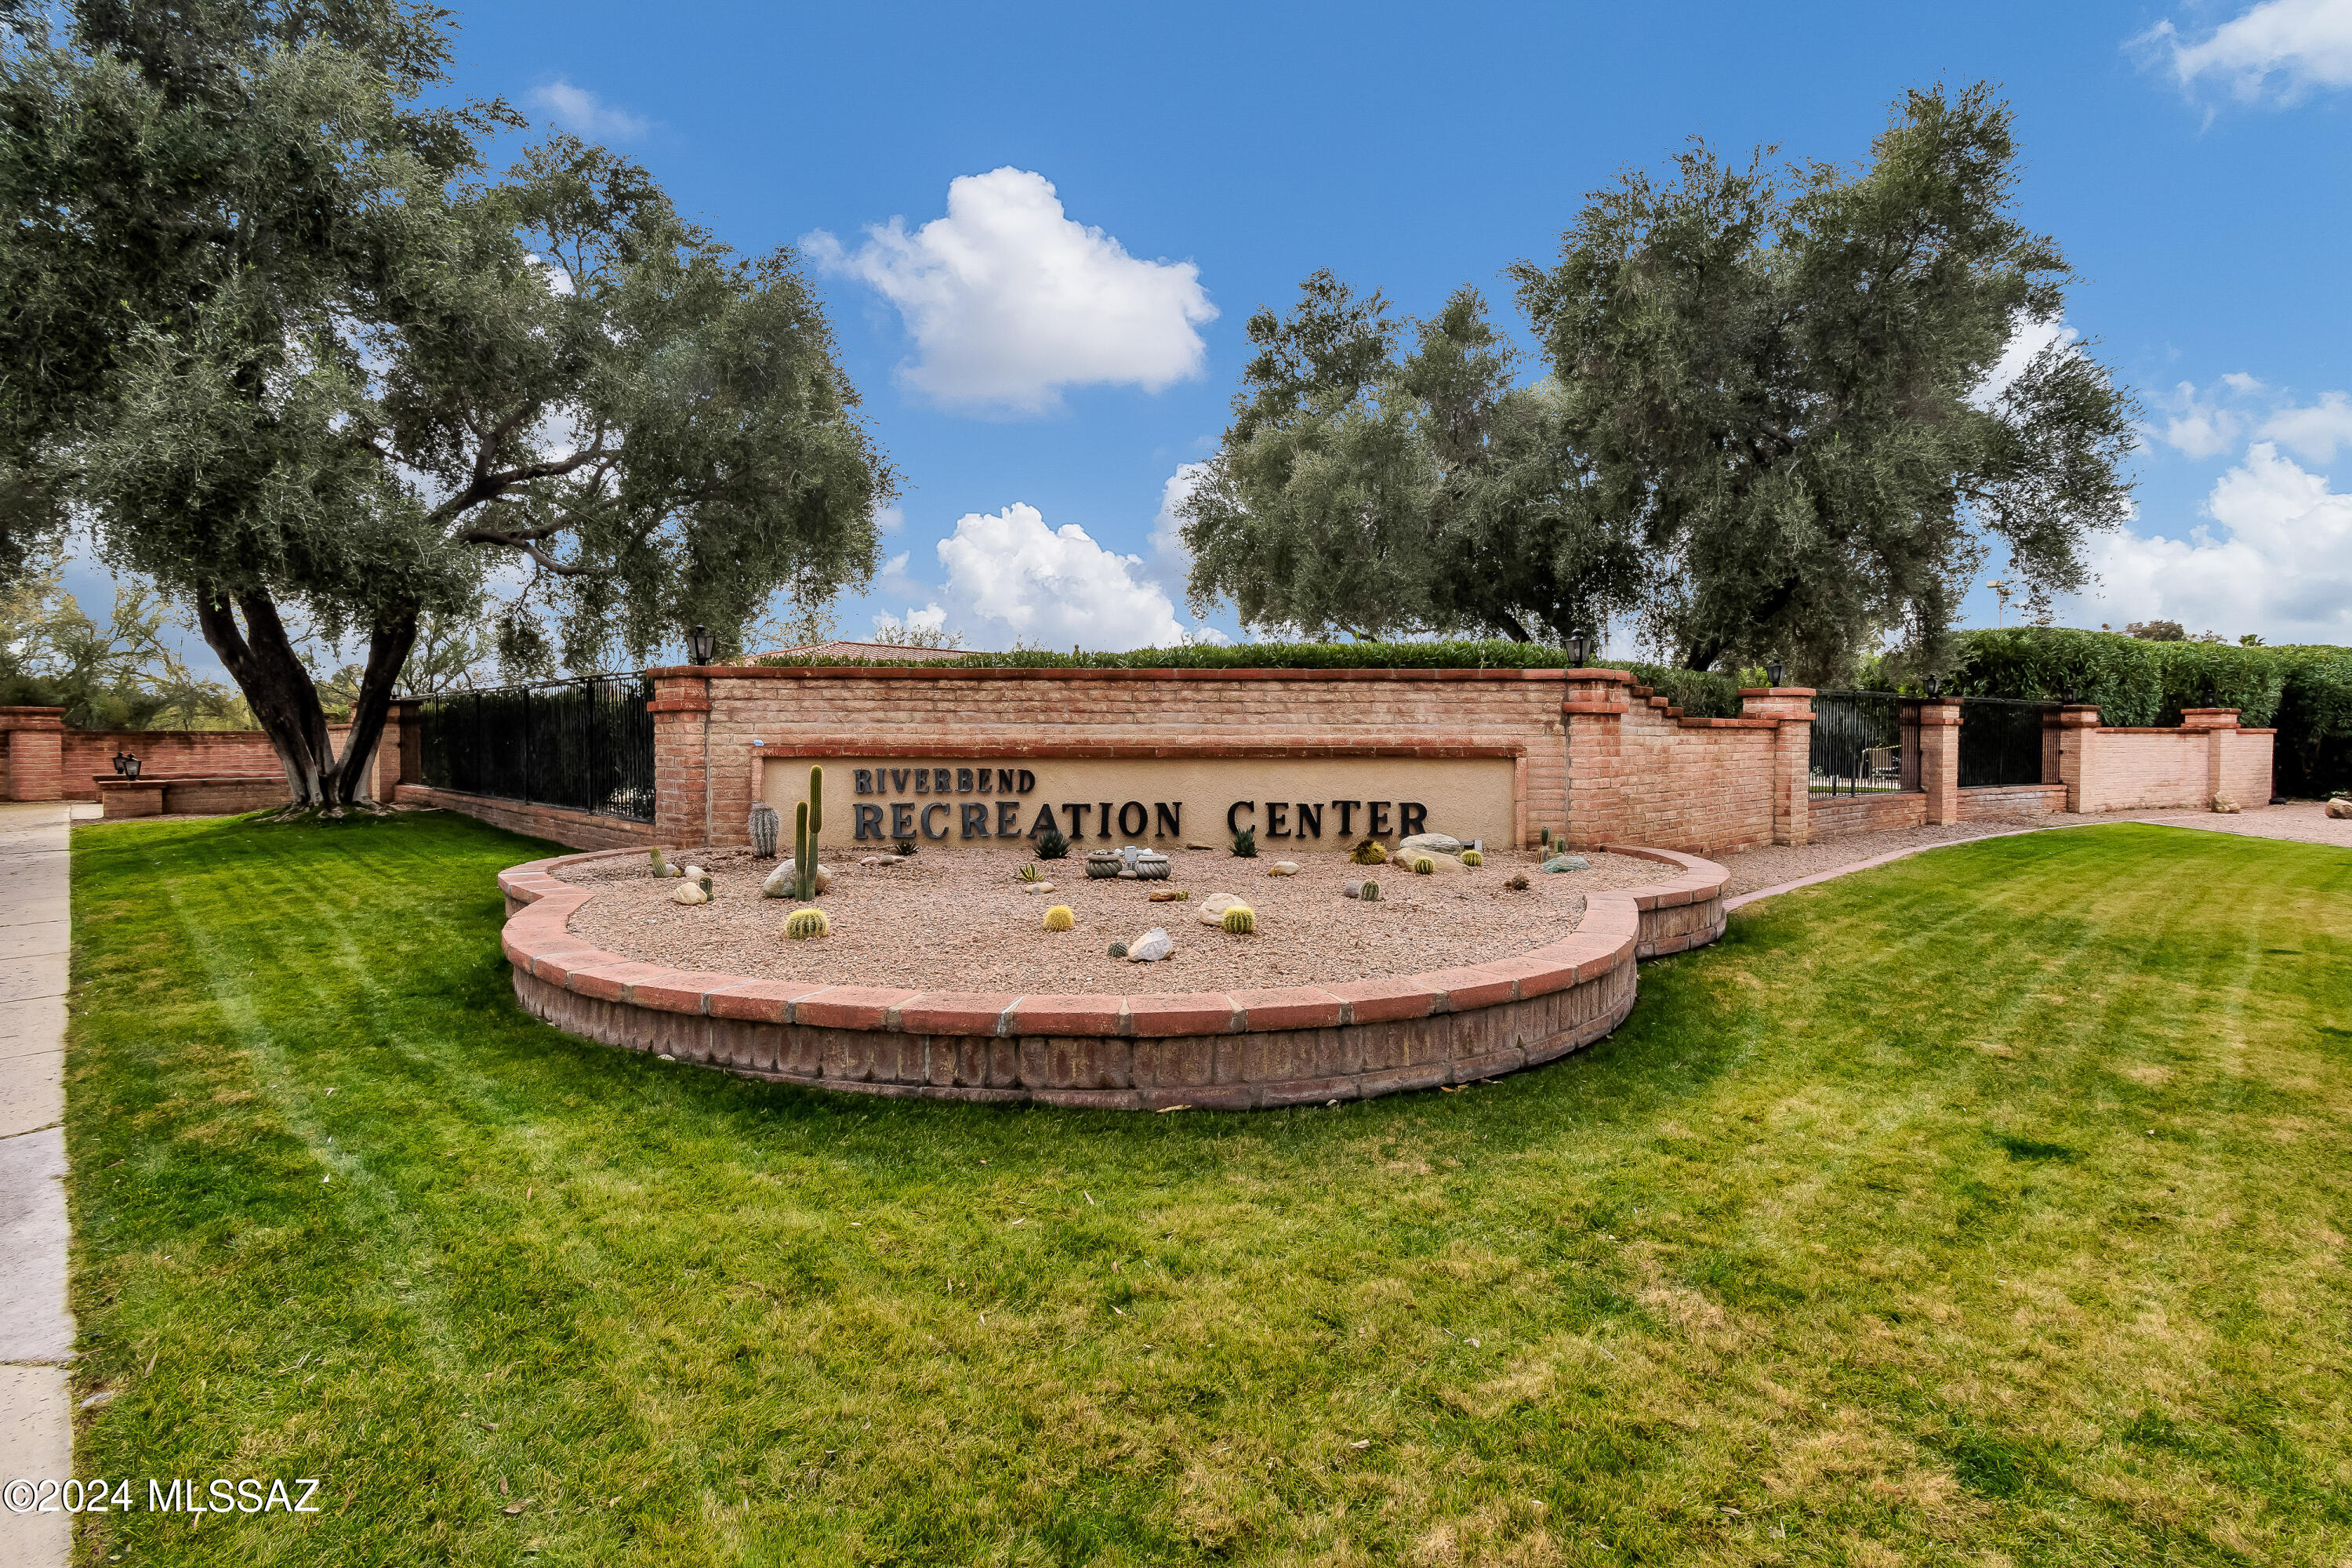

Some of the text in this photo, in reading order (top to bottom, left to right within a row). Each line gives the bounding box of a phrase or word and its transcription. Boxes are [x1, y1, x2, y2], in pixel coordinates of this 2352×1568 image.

[854, 768, 1036, 793] RIVERBEND
[854, 800, 1428, 839] RECREATION CENTER
